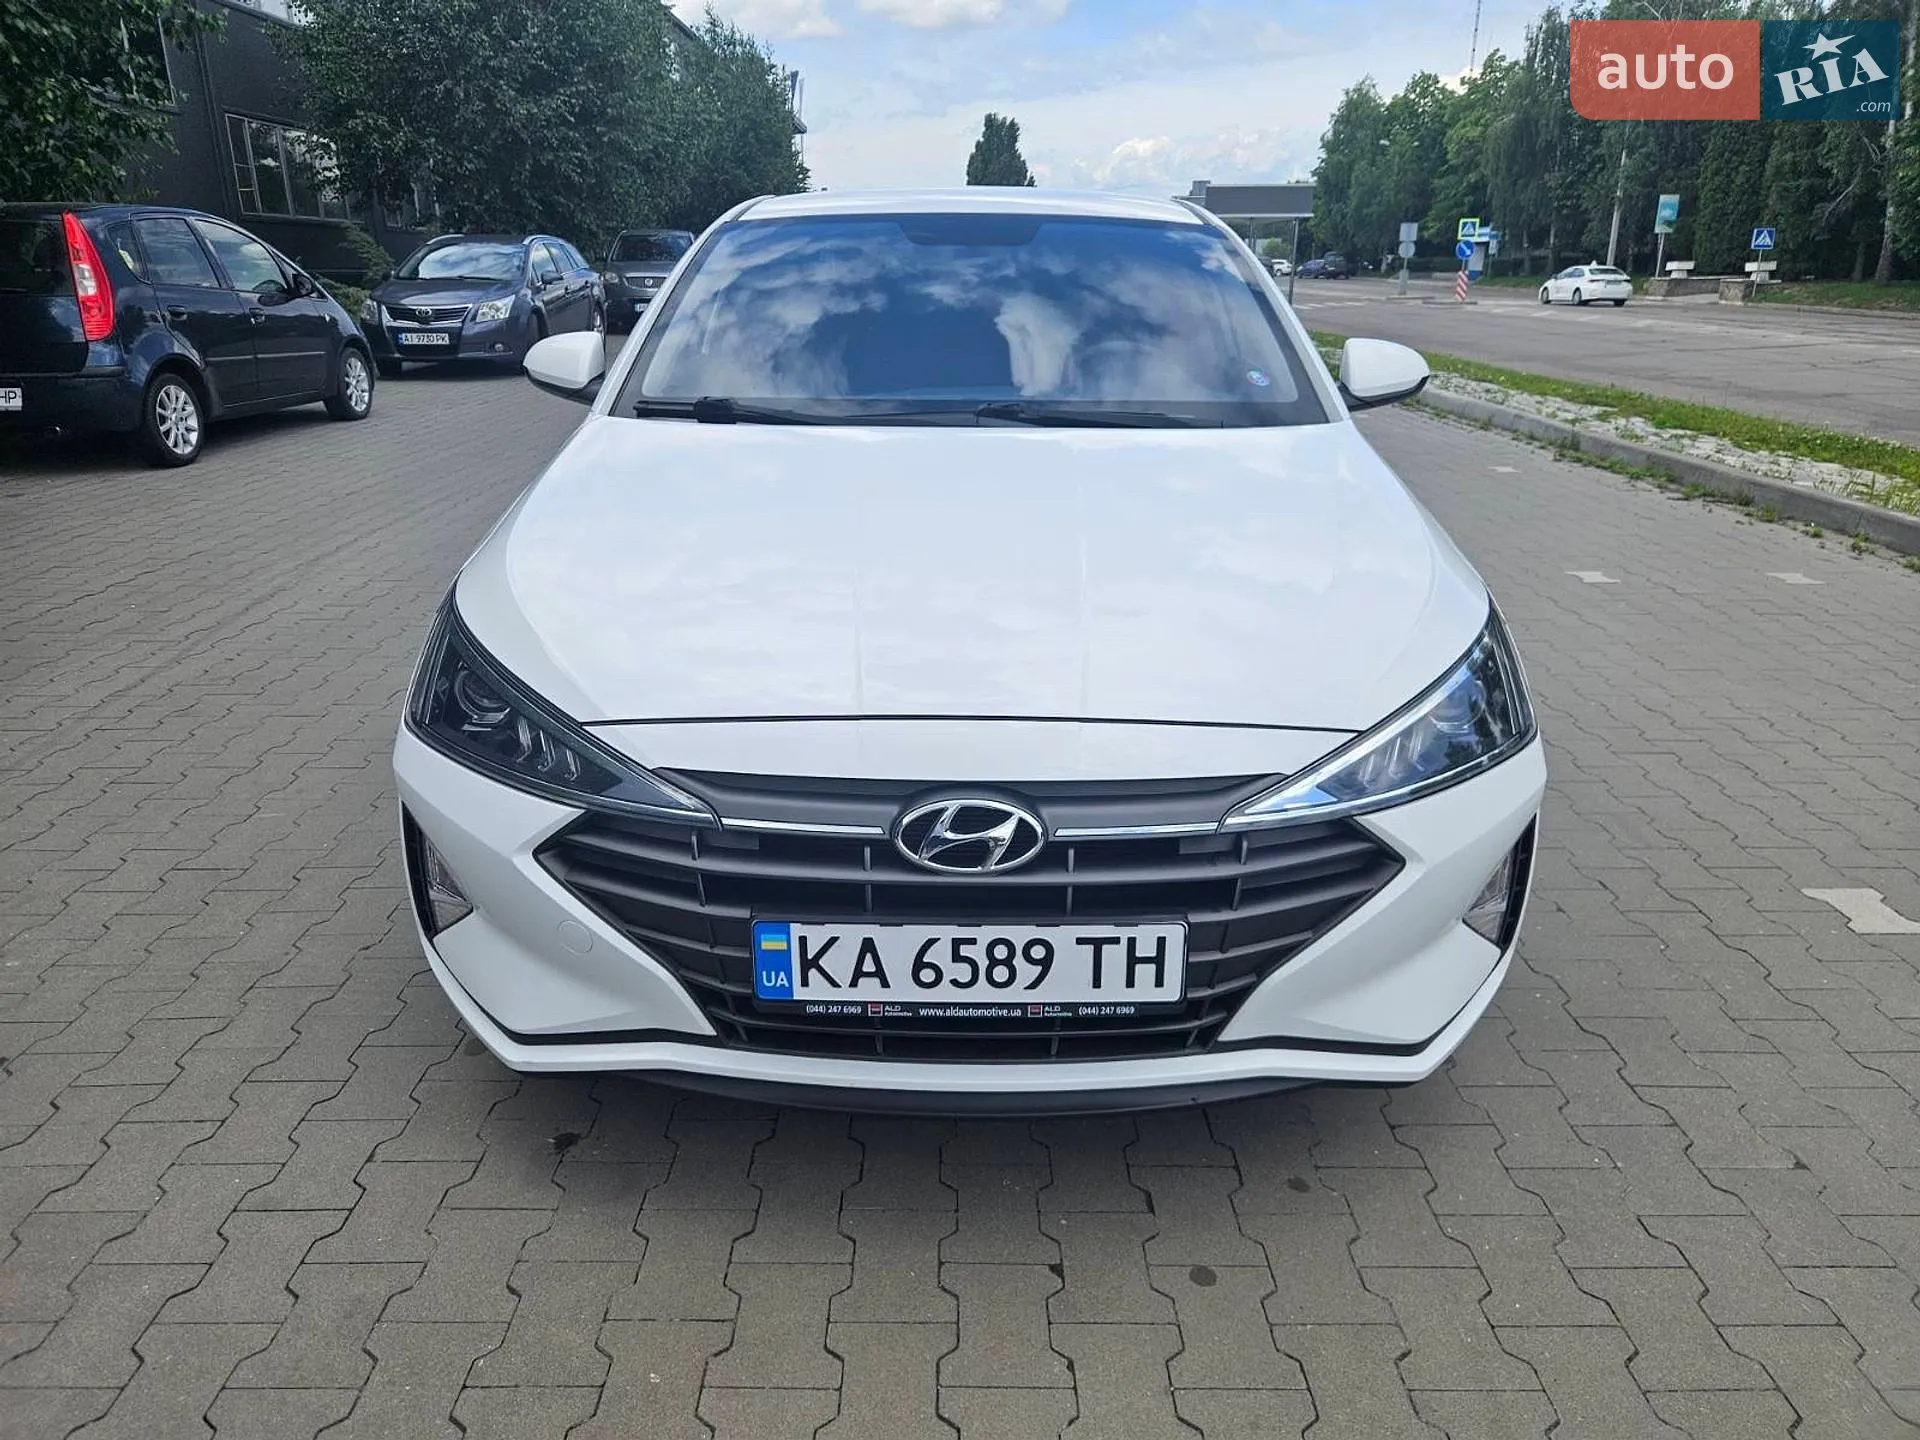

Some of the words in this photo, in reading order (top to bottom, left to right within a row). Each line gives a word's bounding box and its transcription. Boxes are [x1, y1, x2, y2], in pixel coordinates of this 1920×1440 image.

[798, 935, 891, 988] KA
[911, 937, 1055, 990] 6589
[1075, 936, 1167, 989] TH
[762, 970, 789, 987] UA
[806, 1004, 826, 1014] (044)
[827, 1005, 841, 1014] 247
[919, 1006, 1022, 1017] www.aldautomotive.ua
[1100, 1006, 1115, 1015] 247
